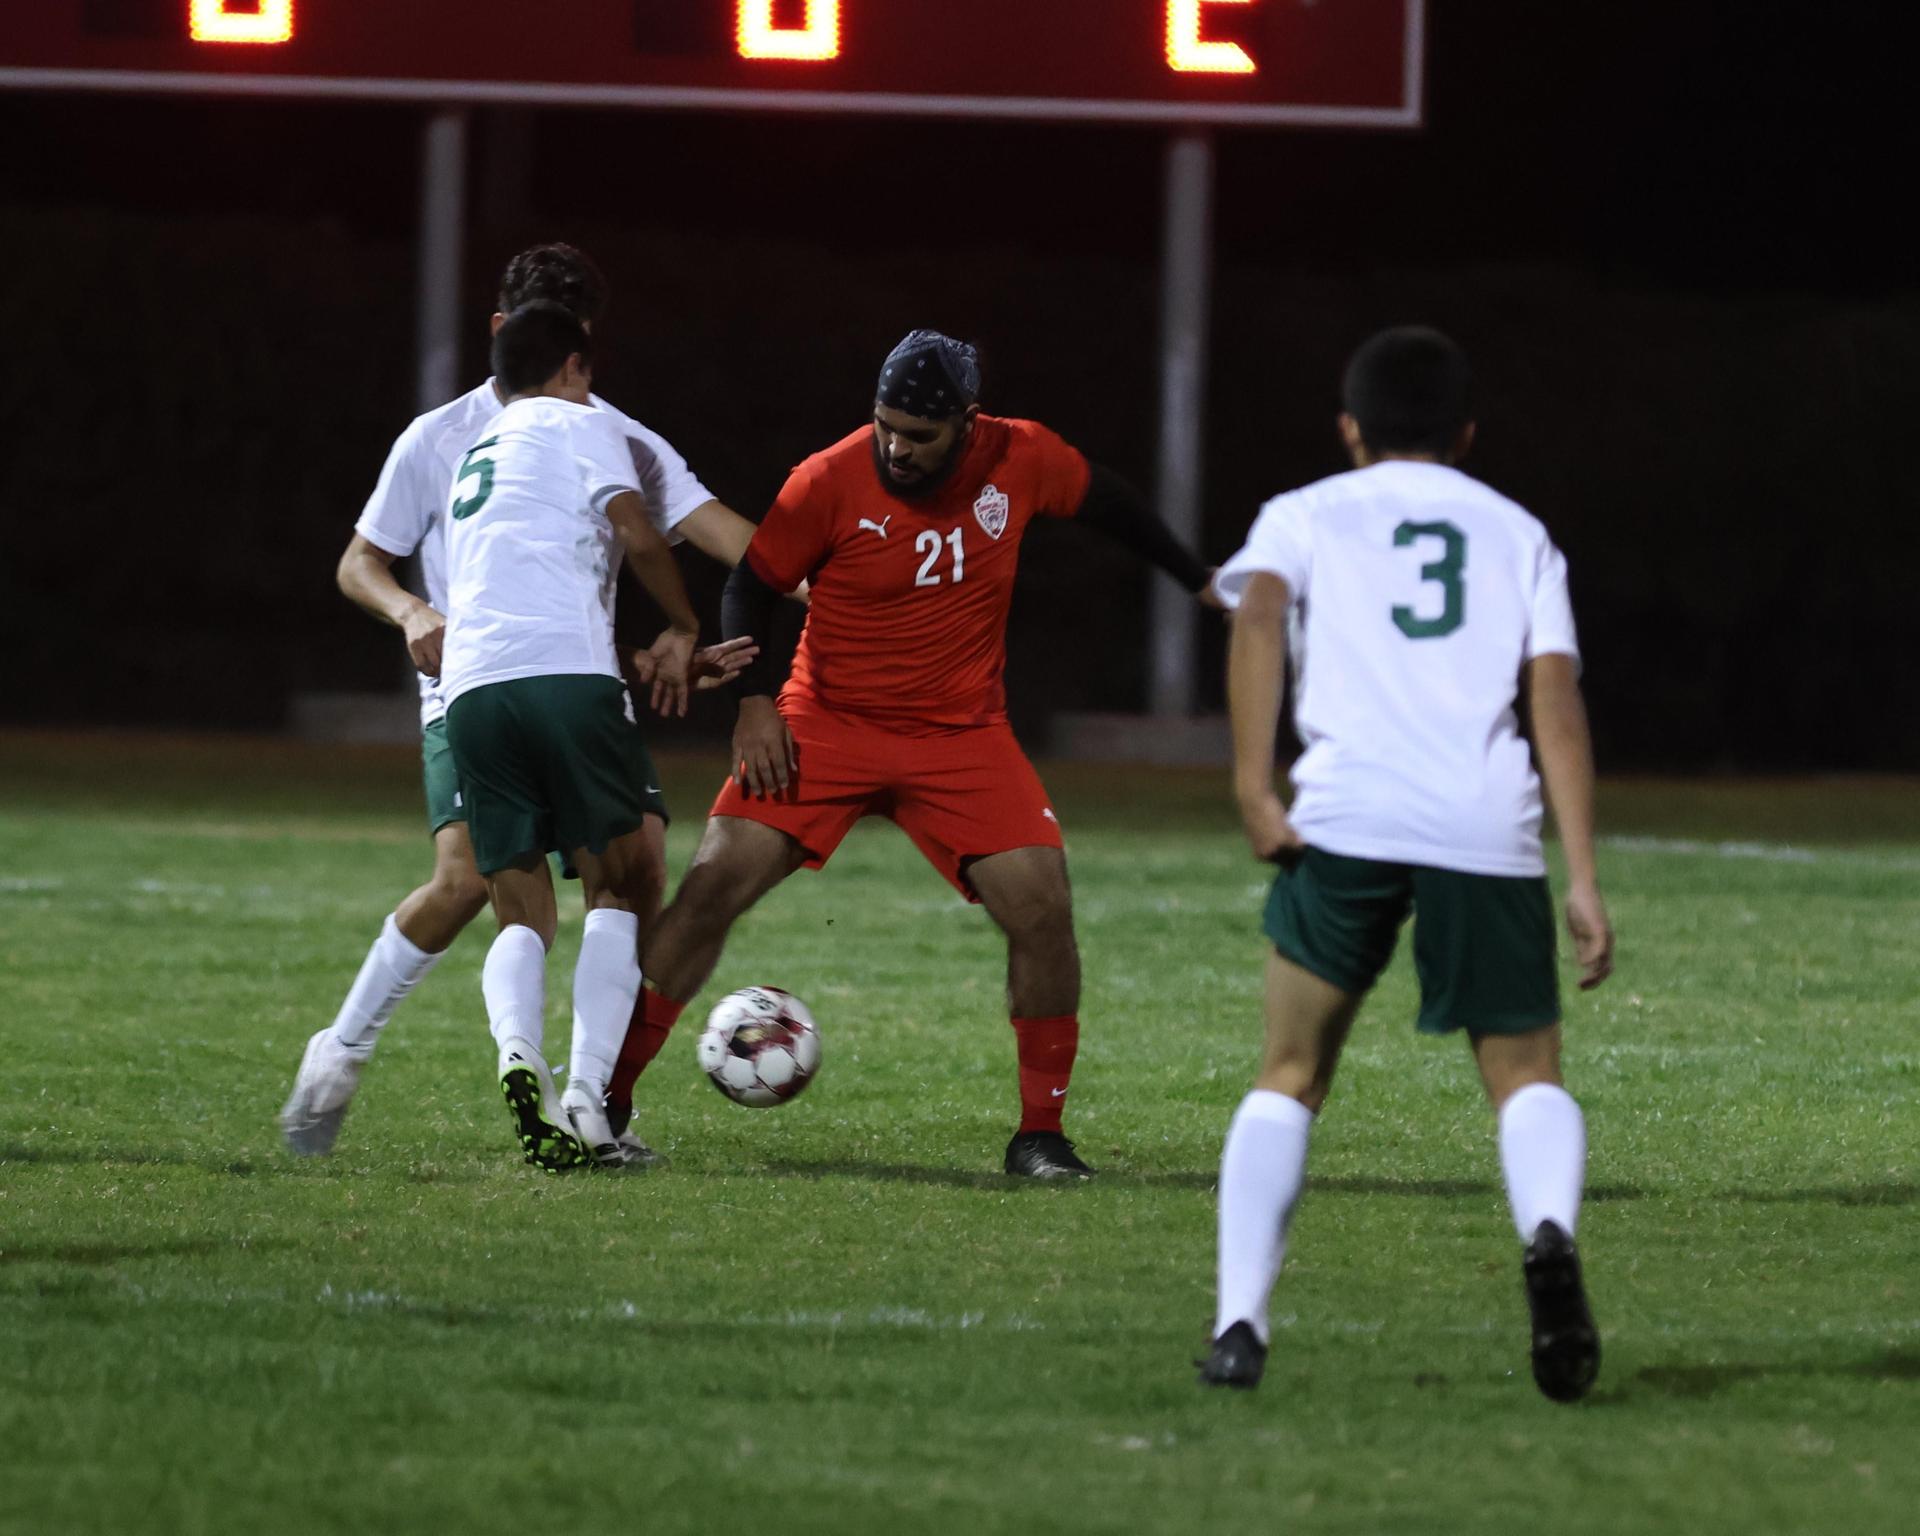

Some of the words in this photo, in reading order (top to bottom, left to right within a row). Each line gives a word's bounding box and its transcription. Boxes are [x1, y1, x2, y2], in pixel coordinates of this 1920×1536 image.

[452, 435, 499, 521] 5
[915, 527, 965, 587] 21
[1391, 519, 1468, 640] 3
